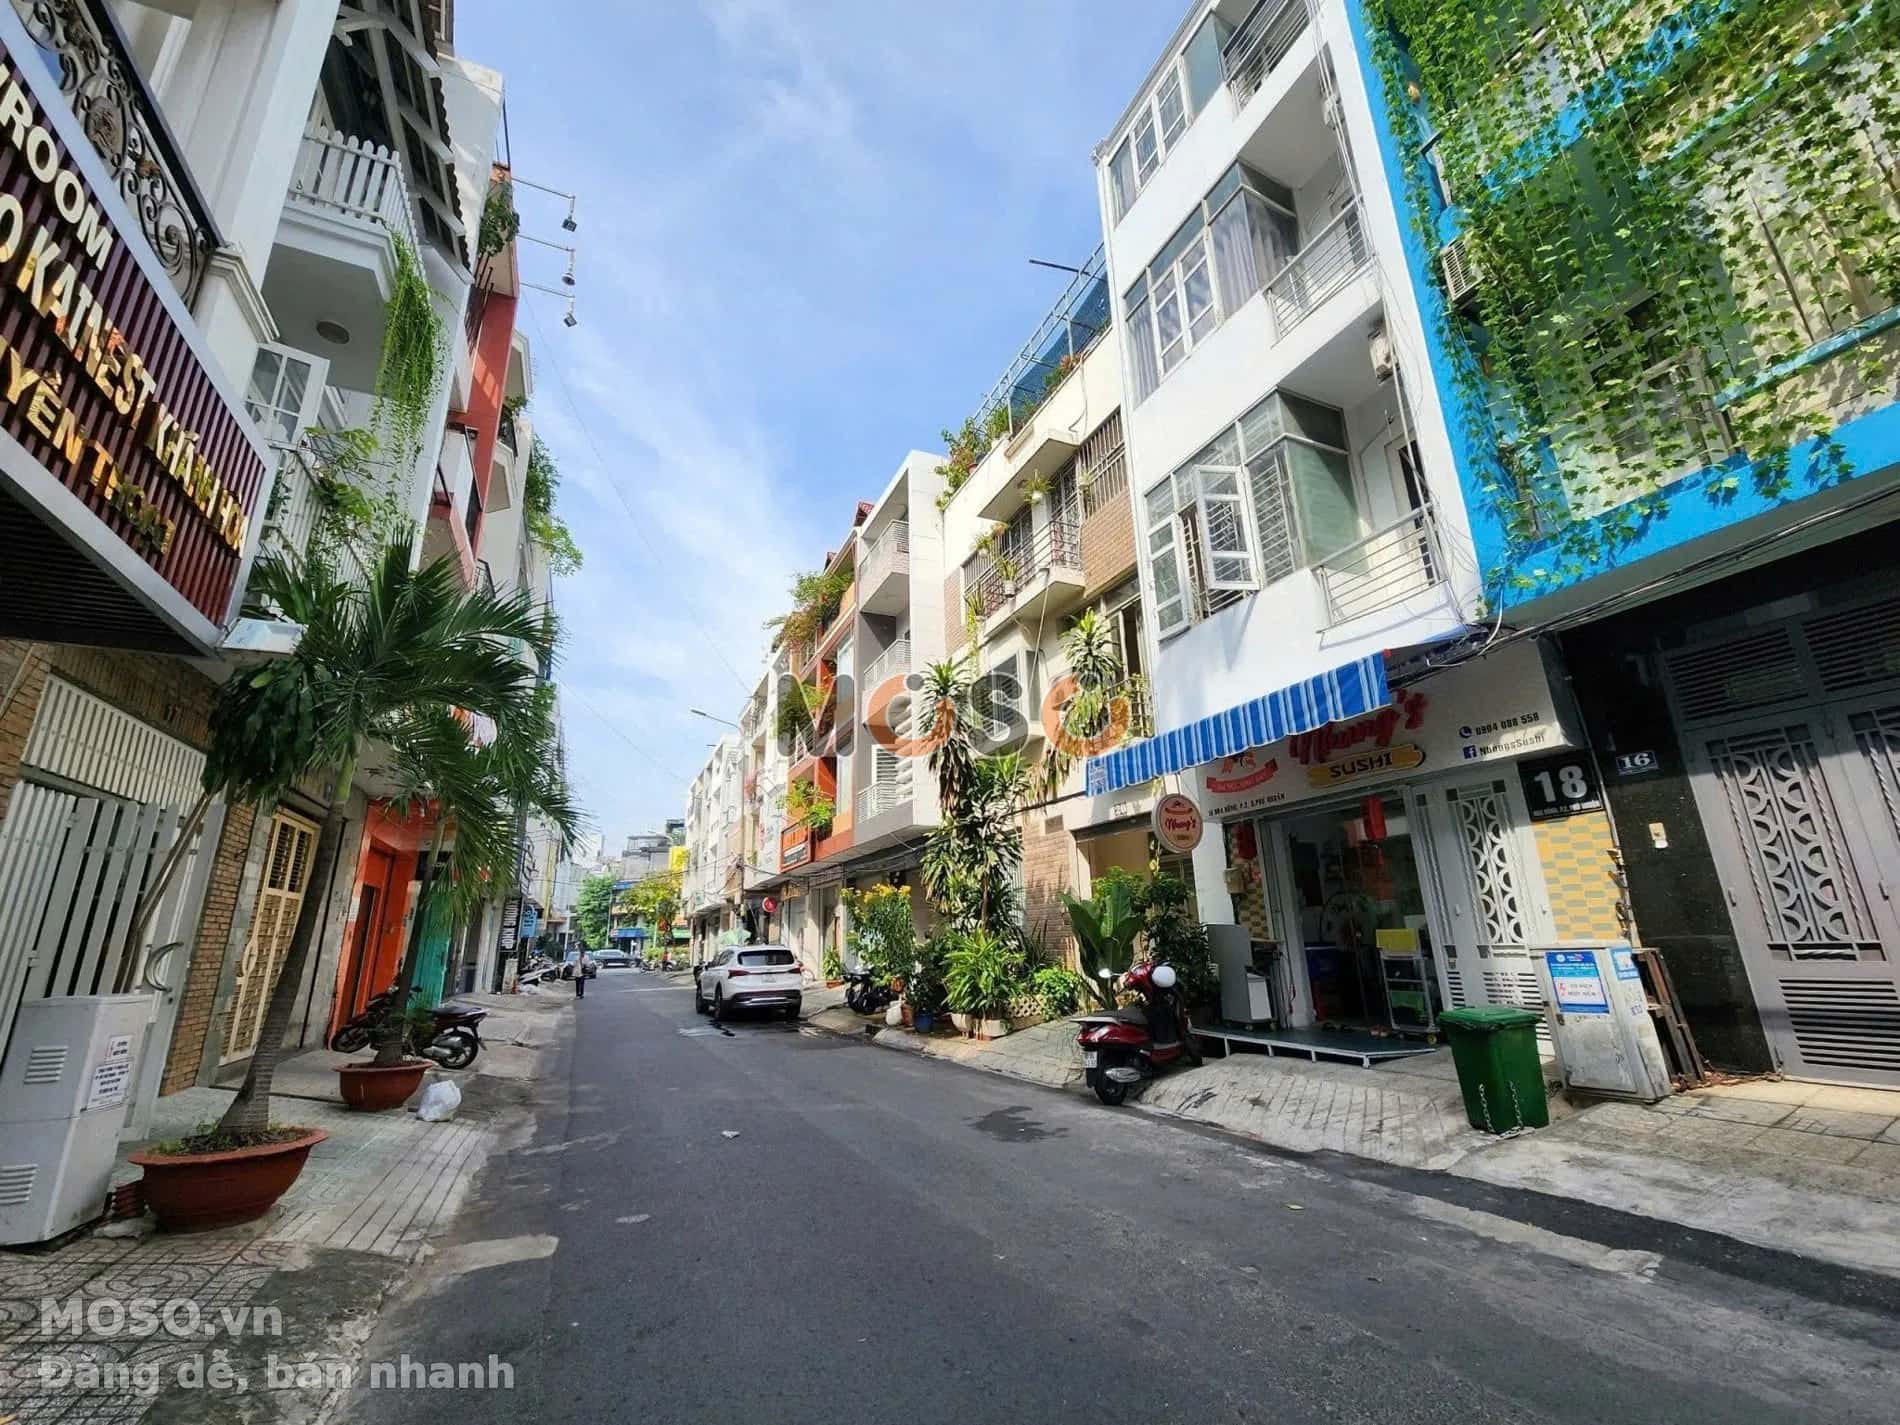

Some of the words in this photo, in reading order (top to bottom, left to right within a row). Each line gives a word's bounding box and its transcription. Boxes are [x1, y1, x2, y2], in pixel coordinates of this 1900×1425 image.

[16, 224, 156, 430] KAINEST
[1329, 752, 1393, 778] SUSHI
[1621, 753, 1650, 769] 16
[1534, 765, 1588, 802] 18
